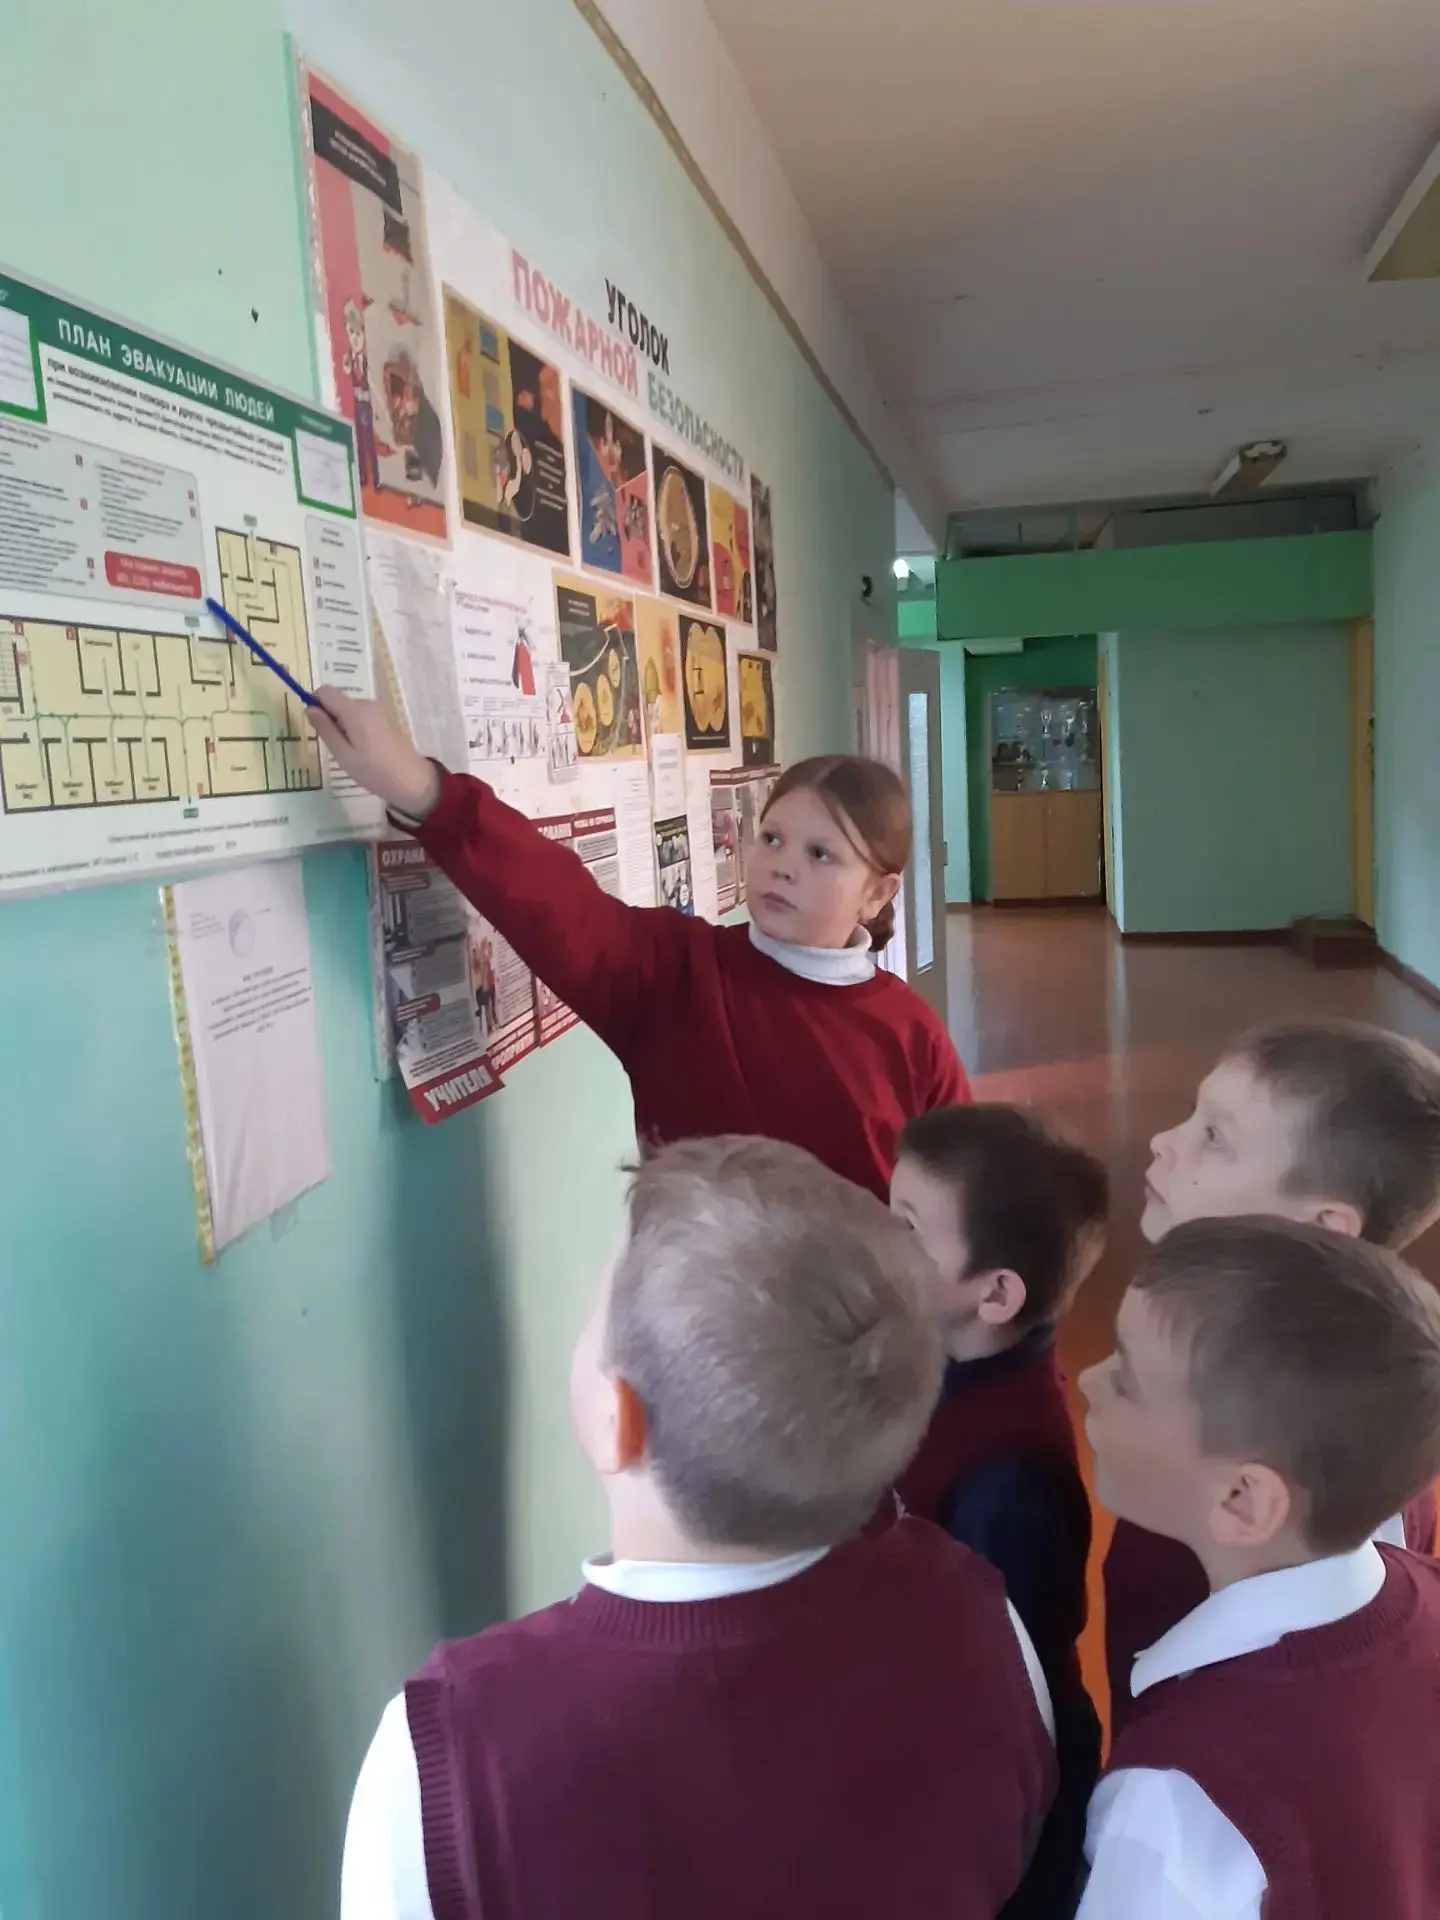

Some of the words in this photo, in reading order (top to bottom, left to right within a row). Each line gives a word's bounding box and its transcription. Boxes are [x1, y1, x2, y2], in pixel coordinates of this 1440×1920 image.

[58, 317, 112, 359] ПЛАН
[121, 344, 218, 401] ЭВАКУАЦИИ
[225, 387, 275, 425] ЛЮДЕЙ
[512, 248, 638, 396] ПОЖАРНОЙ
[647, 370, 744, 482] БЕЗОПАСНОСТИ
[604, 276, 670, 376] УГОЛОК
